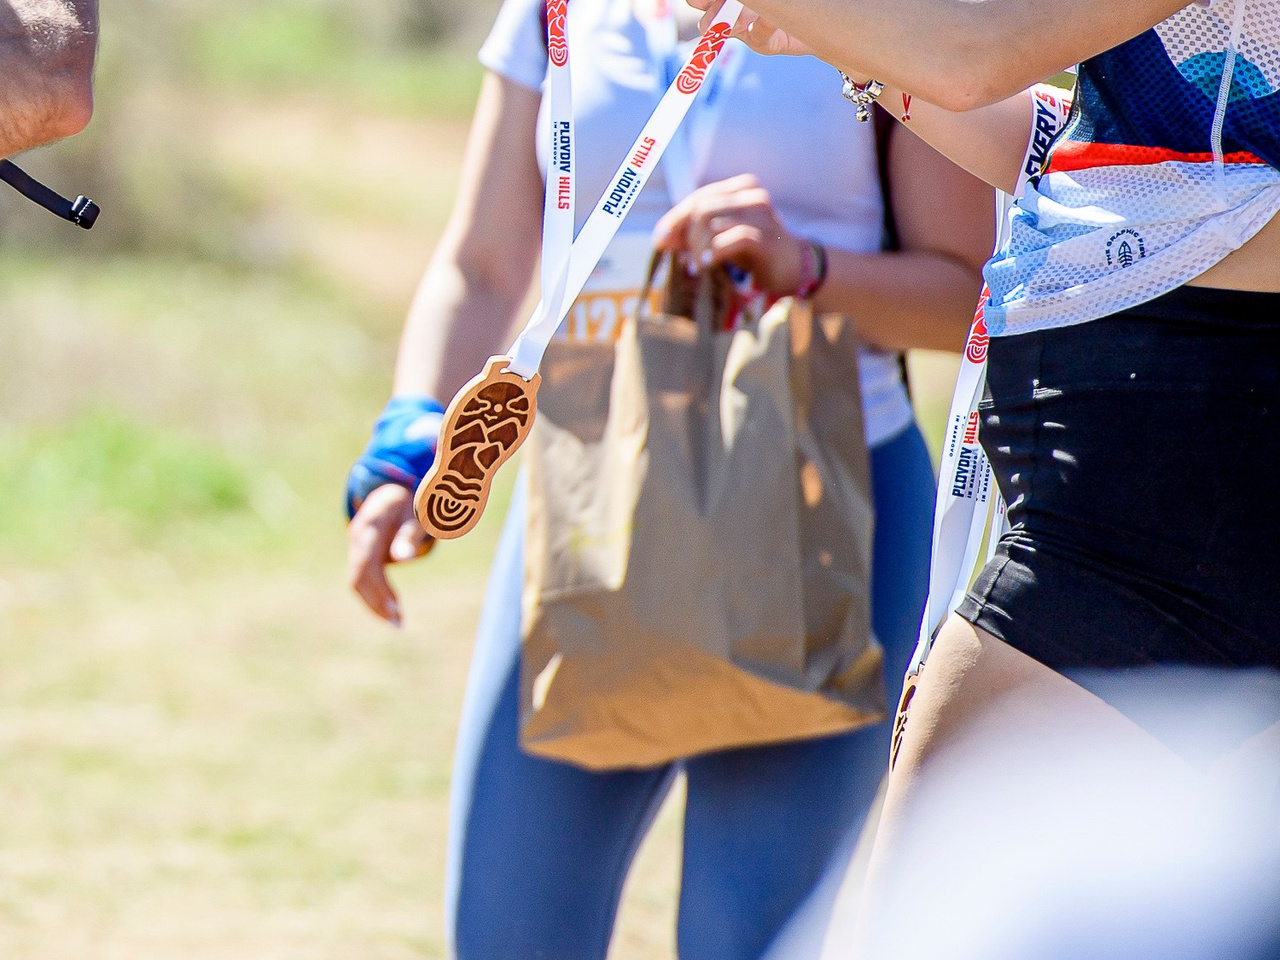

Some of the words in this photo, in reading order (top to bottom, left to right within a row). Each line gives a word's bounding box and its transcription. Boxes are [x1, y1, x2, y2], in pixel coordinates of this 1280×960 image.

[559, 121, 571, 173] PLOVDIV
[1025, 99, 1057, 176] EVERY
[557, 176, 571, 210] HILLS
[602, 166, 637, 215] PLOVDIV
[630, 136, 656, 168] HILLS
[1105, 249, 1113, 266] THE
[1106, 228, 1139, 247] GRAPHIC
[952, 446, 973, 497] PLOVDIV
[963, 411, 978, 444] HILLS
